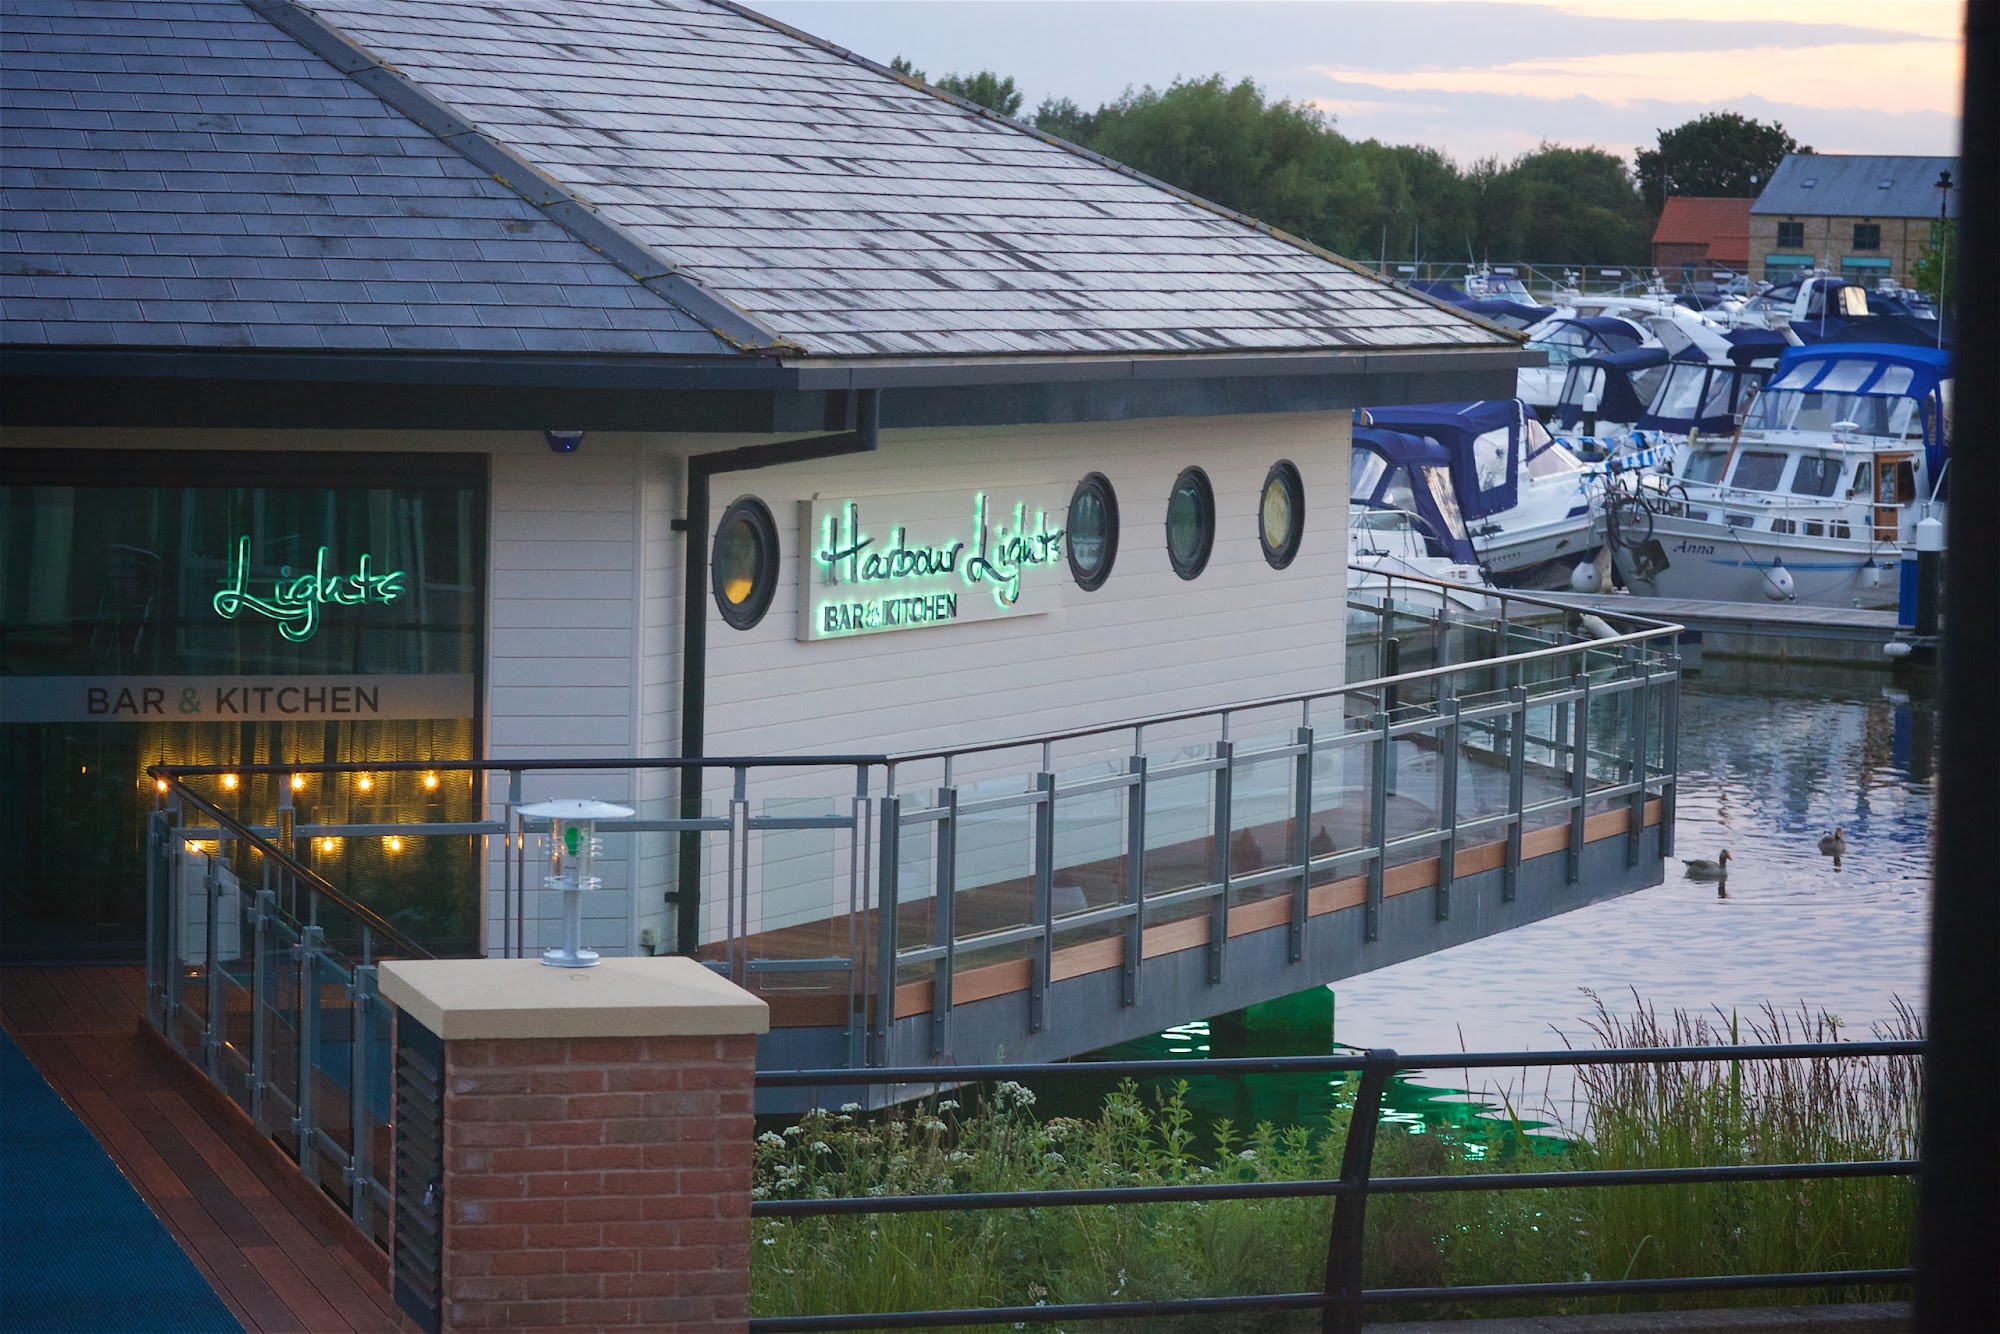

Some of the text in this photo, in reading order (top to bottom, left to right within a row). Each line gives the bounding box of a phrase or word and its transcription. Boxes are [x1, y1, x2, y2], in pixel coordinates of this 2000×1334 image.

[820, 495, 1065, 606] Harbour Lights
[1673, 540, 1715, 555] Anna
[213, 535, 406, 642] Lights
[823, 603, 864, 632] BAR
[882, 593, 957, 626] KITCHEN
[87, 686, 379, 715] BAR & KITCHEN
